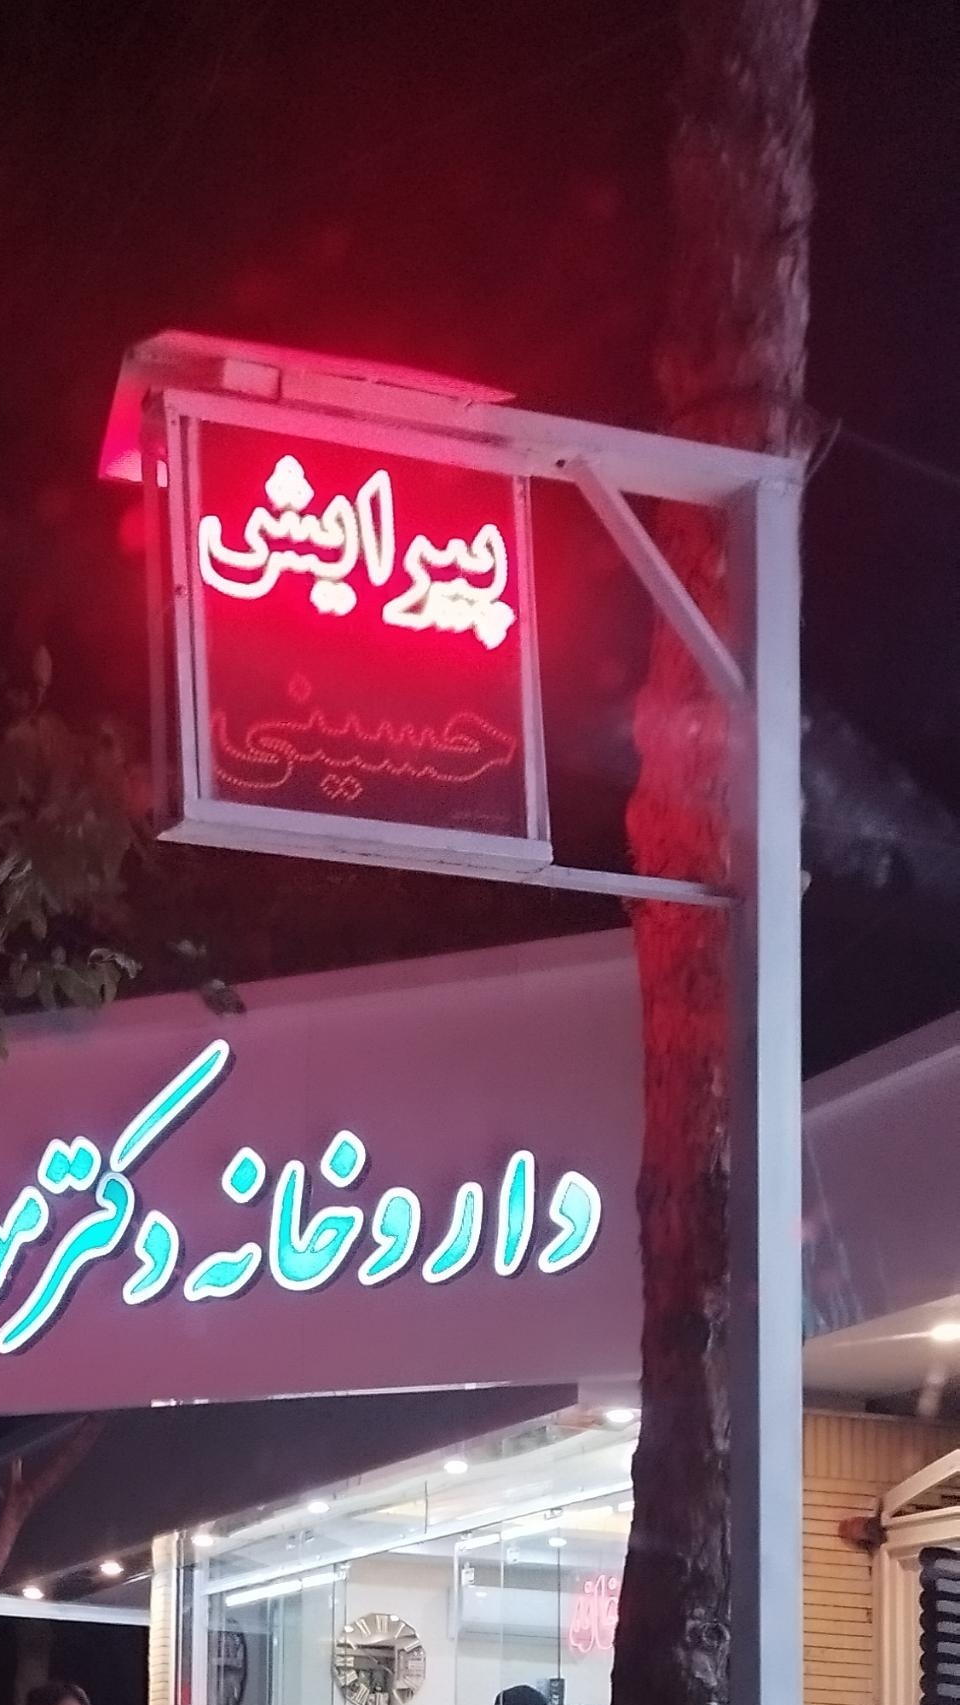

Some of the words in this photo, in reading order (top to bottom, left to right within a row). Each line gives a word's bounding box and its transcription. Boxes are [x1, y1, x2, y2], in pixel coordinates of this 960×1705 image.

[198, 455, 516, 650] پیرایش
[213, 672, 517, 802] حسینی
[183, 1129, 602, 1302] داروخانه
